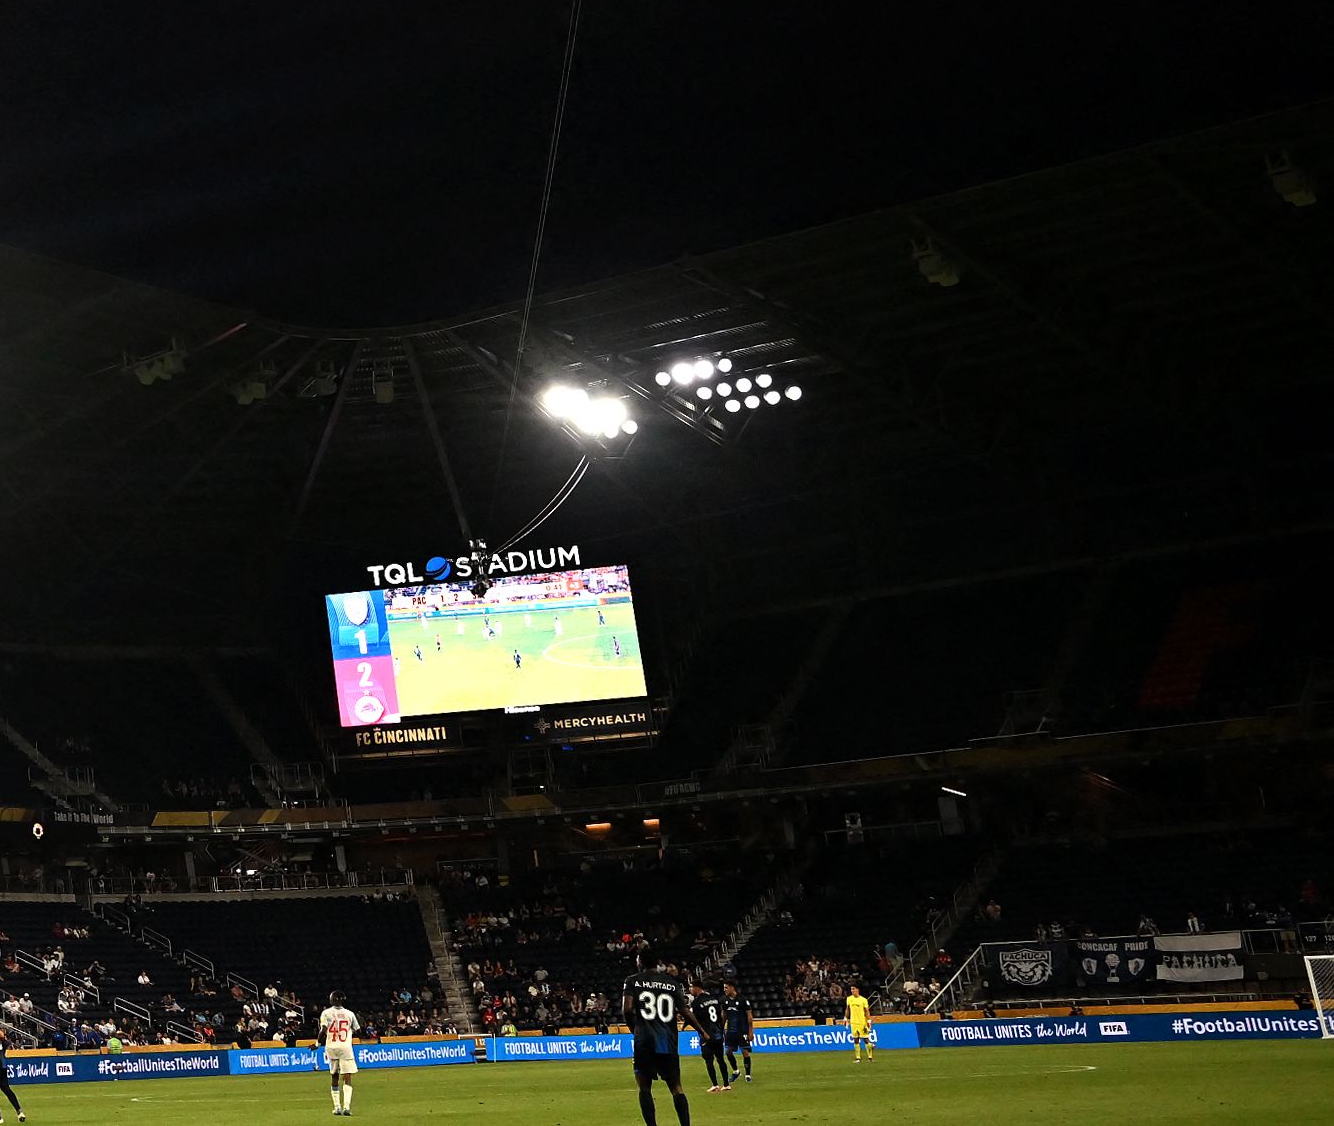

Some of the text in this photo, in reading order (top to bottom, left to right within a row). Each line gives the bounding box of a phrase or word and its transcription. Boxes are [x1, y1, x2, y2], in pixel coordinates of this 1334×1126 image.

[367, 561, 424, 586] TQL
[354, 629, 368, 655] 1
[357, 662, 373, 687] 2
[554, 712, 646, 729] MERCYHEALTH
[355, 726, 447, 747] FC CINCINNATI
[1124, 940, 1149, 952] PRIDE
[1002, 953, 1048, 961] PACHUCA
[639, 991, 674, 1023] 30
[708, 1006, 718, 1022] 8
[328, 1020, 349, 1043] 45
[941, 1022, 1087, 1041] FOOTBALL UNITES the World
[1103, 1025, 1123, 1033] FIFA
[358, 1045, 466, 1063] #FootballUnitesTheWorld
[504, 1039, 621, 1055] FOOTBALL UNITES the World
[240, 1051, 318, 1068] FOOTBALL UNITES the World
[16, 1063, 28, 1077] the
[28, 1062, 49, 1078] World
